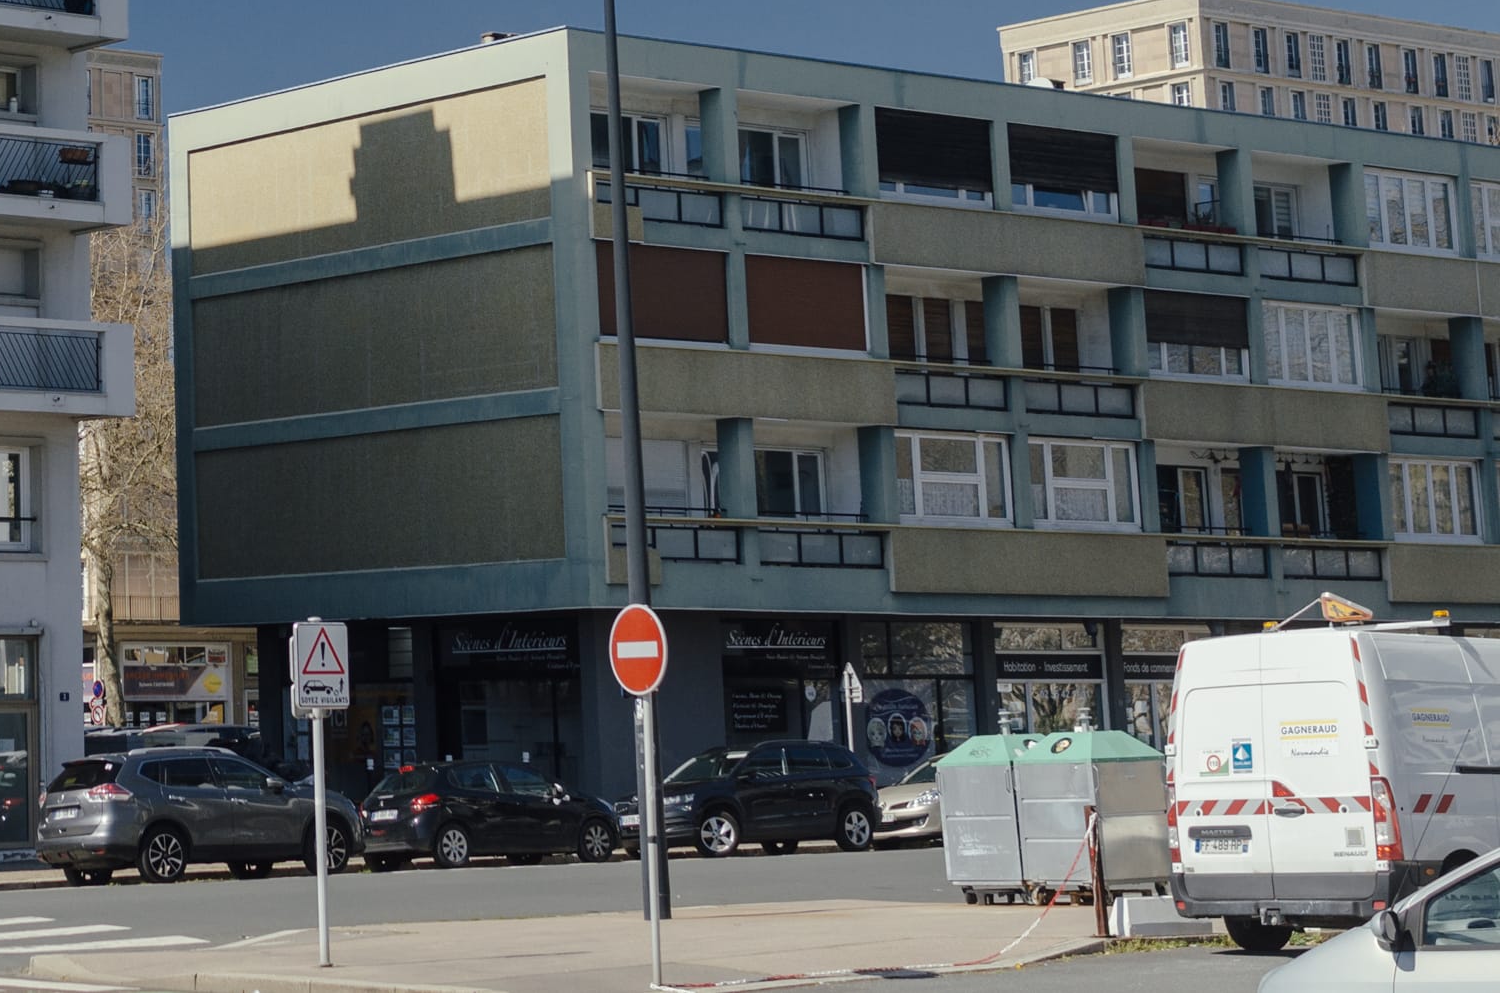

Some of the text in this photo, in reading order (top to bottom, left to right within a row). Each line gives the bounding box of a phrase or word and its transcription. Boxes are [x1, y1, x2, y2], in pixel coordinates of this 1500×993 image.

[451, 630, 491, 651] Scènes
[725, 629, 761, 646] Scènes
[1003, 661, 1037, 672] Habitation
[1044, 661, 1089, 672] Investissement
[1141, 662, 1150, 673] de
[301, 696, 349, 704] SOYEZ VIGILANTS
[1411, 712, 1451, 722] GAGNERAUD
[1280, 724, 1338, 735] GAGNERAUD
[1290, 747, 1330, 757] Normandie
